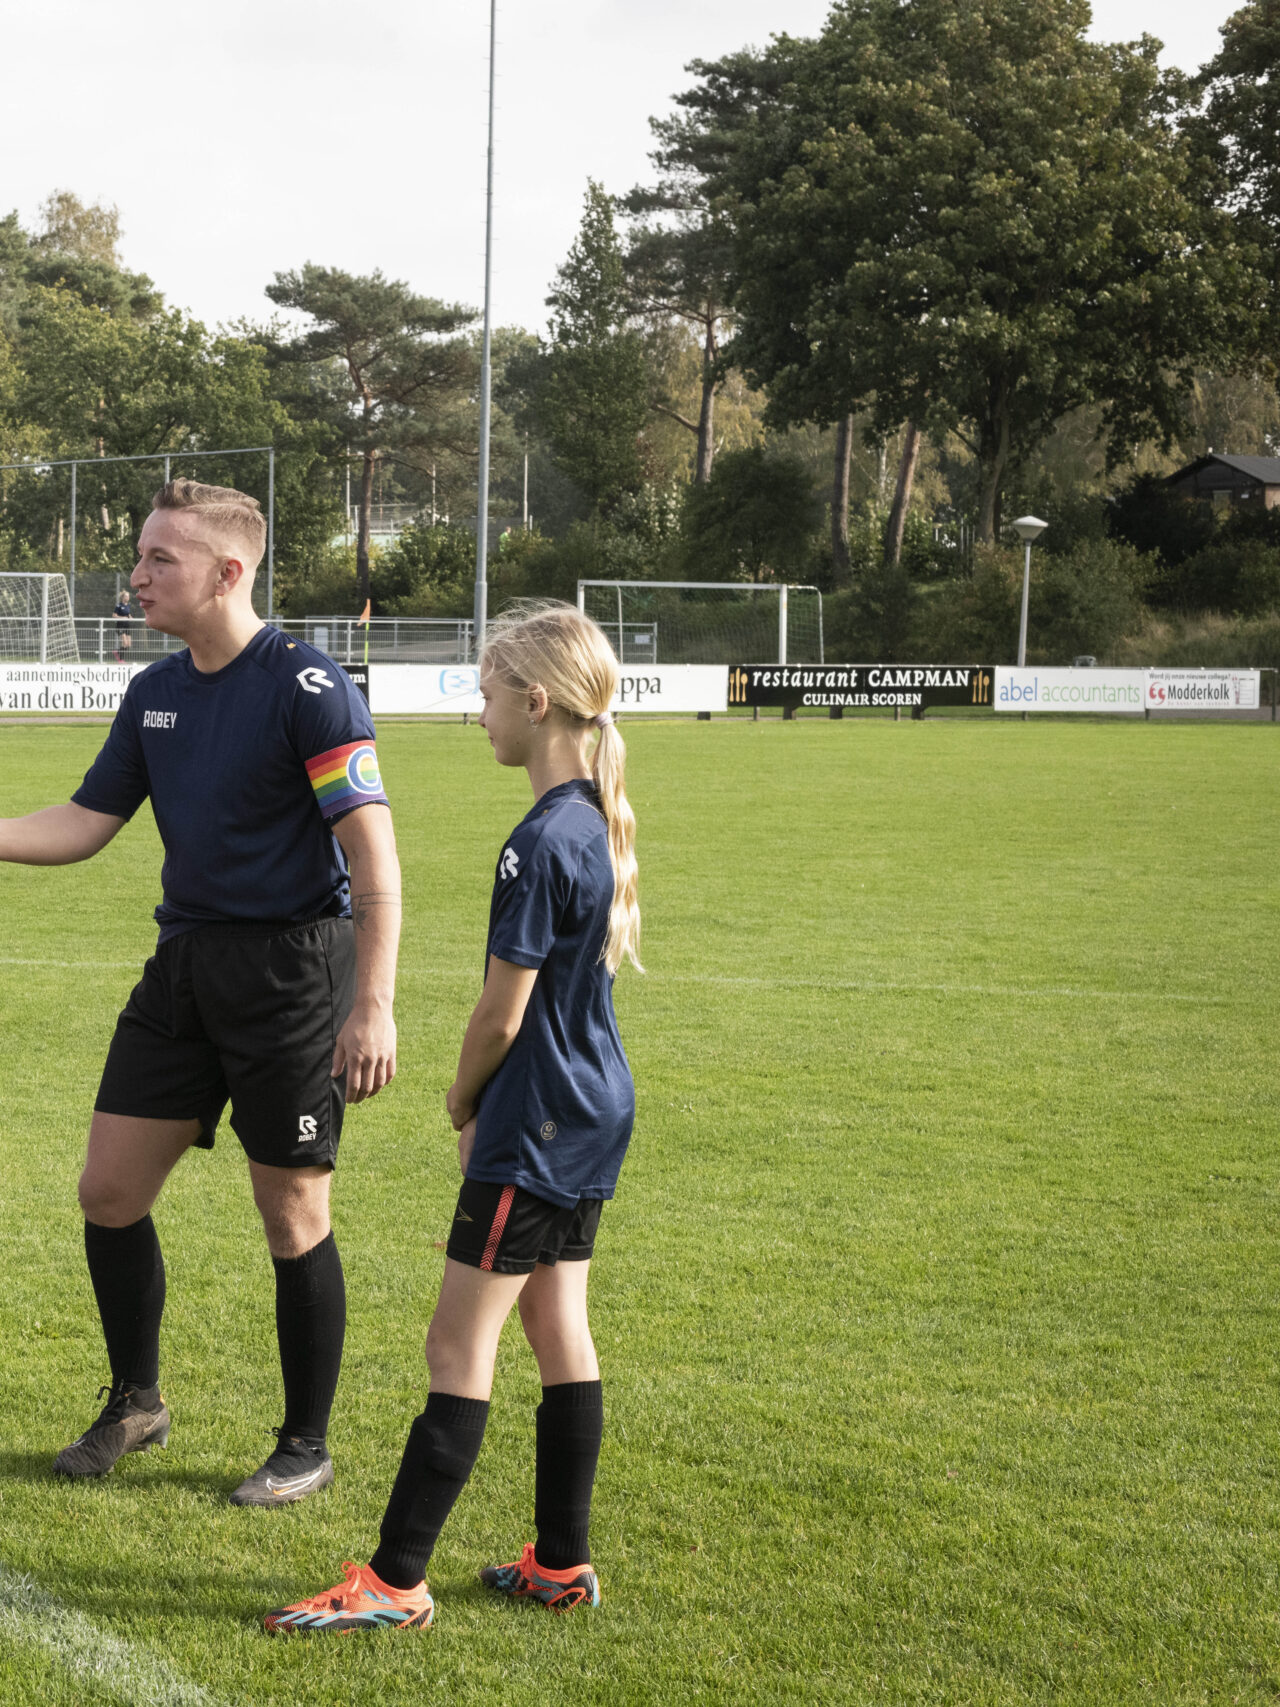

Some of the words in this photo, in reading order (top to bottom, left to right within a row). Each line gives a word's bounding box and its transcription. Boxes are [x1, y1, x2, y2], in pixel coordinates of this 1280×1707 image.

[753, 669, 858, 688] restaurant
[869, 669, 970, 687] CAMPMAN
[38, 686, 74, 709] den
[803, 693, 869, 706] CULINAIR
[872, 693, 922, 705] SCOREN
[1000, 677, 1038, 702] abel
[1041, 680, 1140, 703] accountants
[1167, 683, 1230, 700] Modderkolk
[143, 710, 177, 729] ROBEY
